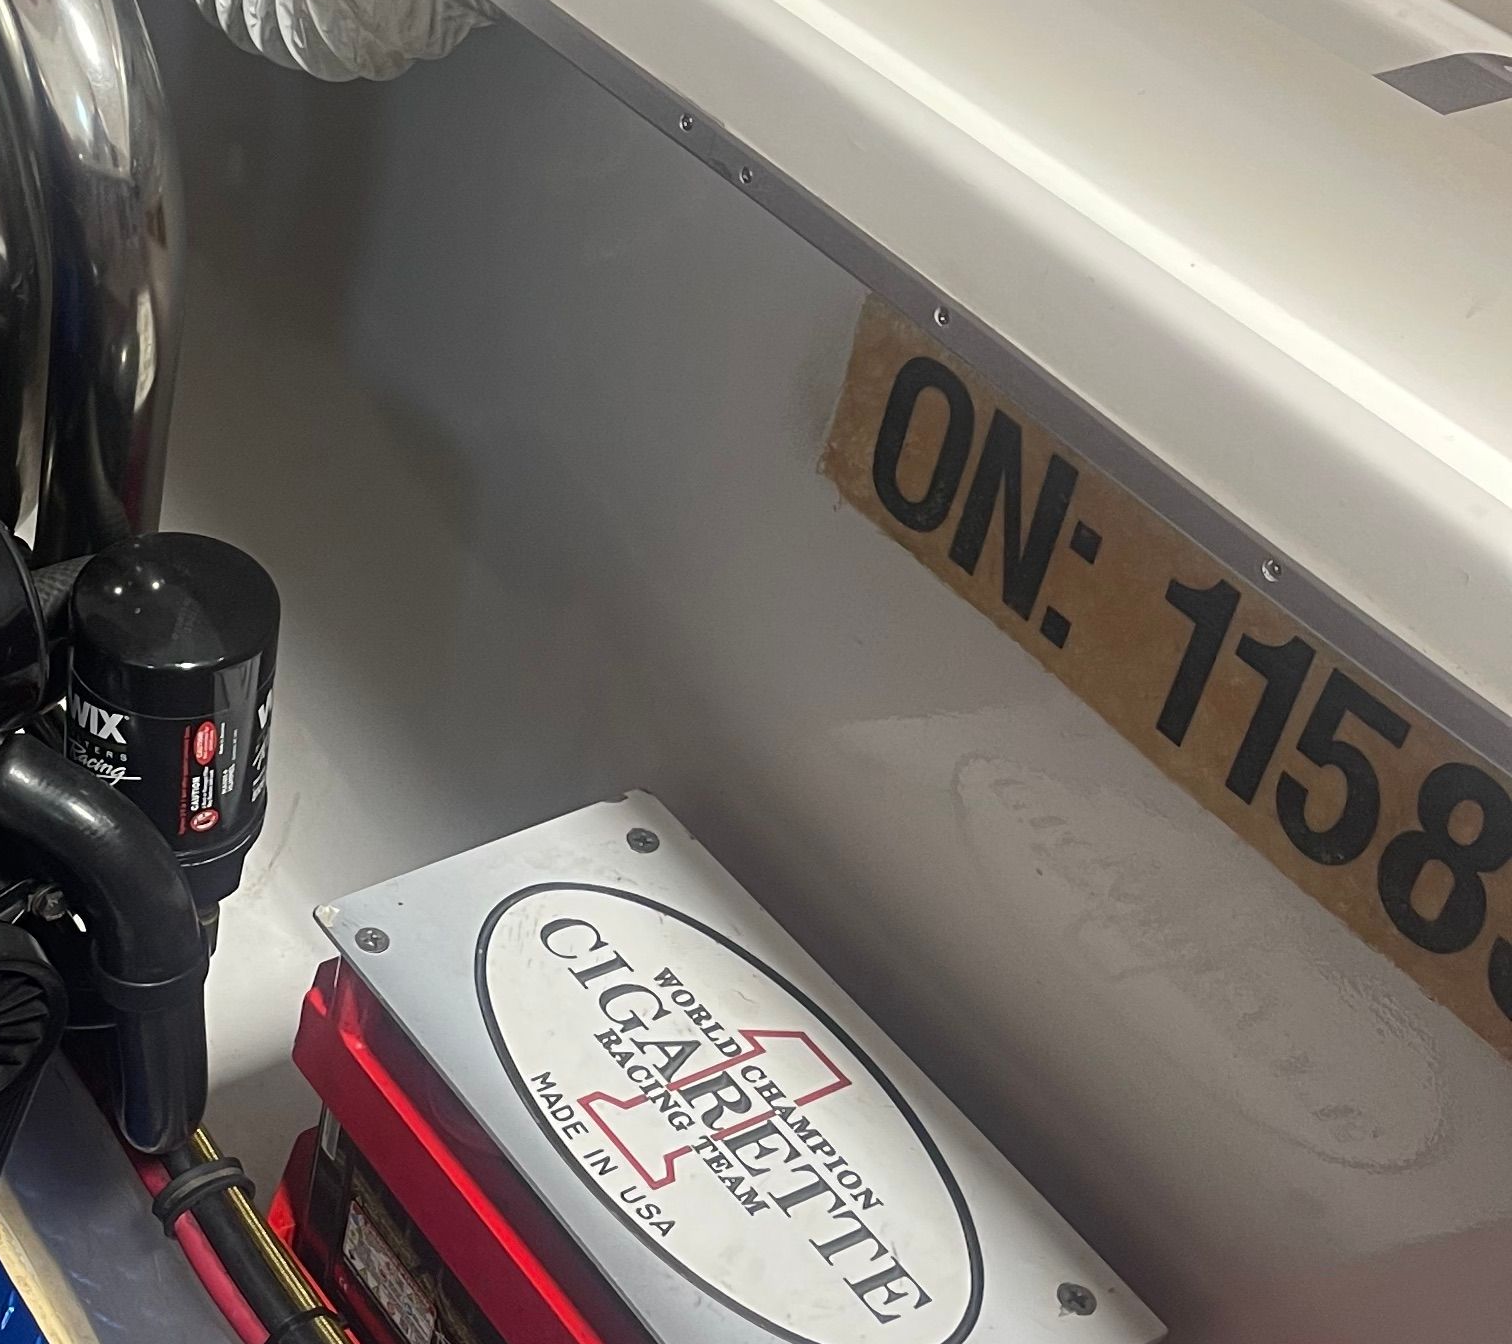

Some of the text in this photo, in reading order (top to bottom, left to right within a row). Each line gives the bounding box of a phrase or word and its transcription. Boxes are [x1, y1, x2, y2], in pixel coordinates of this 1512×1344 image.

[70, 693, 127, 744] WIX
[870, 354, 1103, 649] ON:
[1155, 576, 1512, 1026] 1158
[190, 776, 201, 811] CAUTION
[529, 1070, 677, 1240] MADE IN USA
[538, 916, 934, 1327] CIGARETTE
[593, 1028, 771, 1220] RACING TEAM
[652, 966, 885, 1210] WORLD CHAMPION
